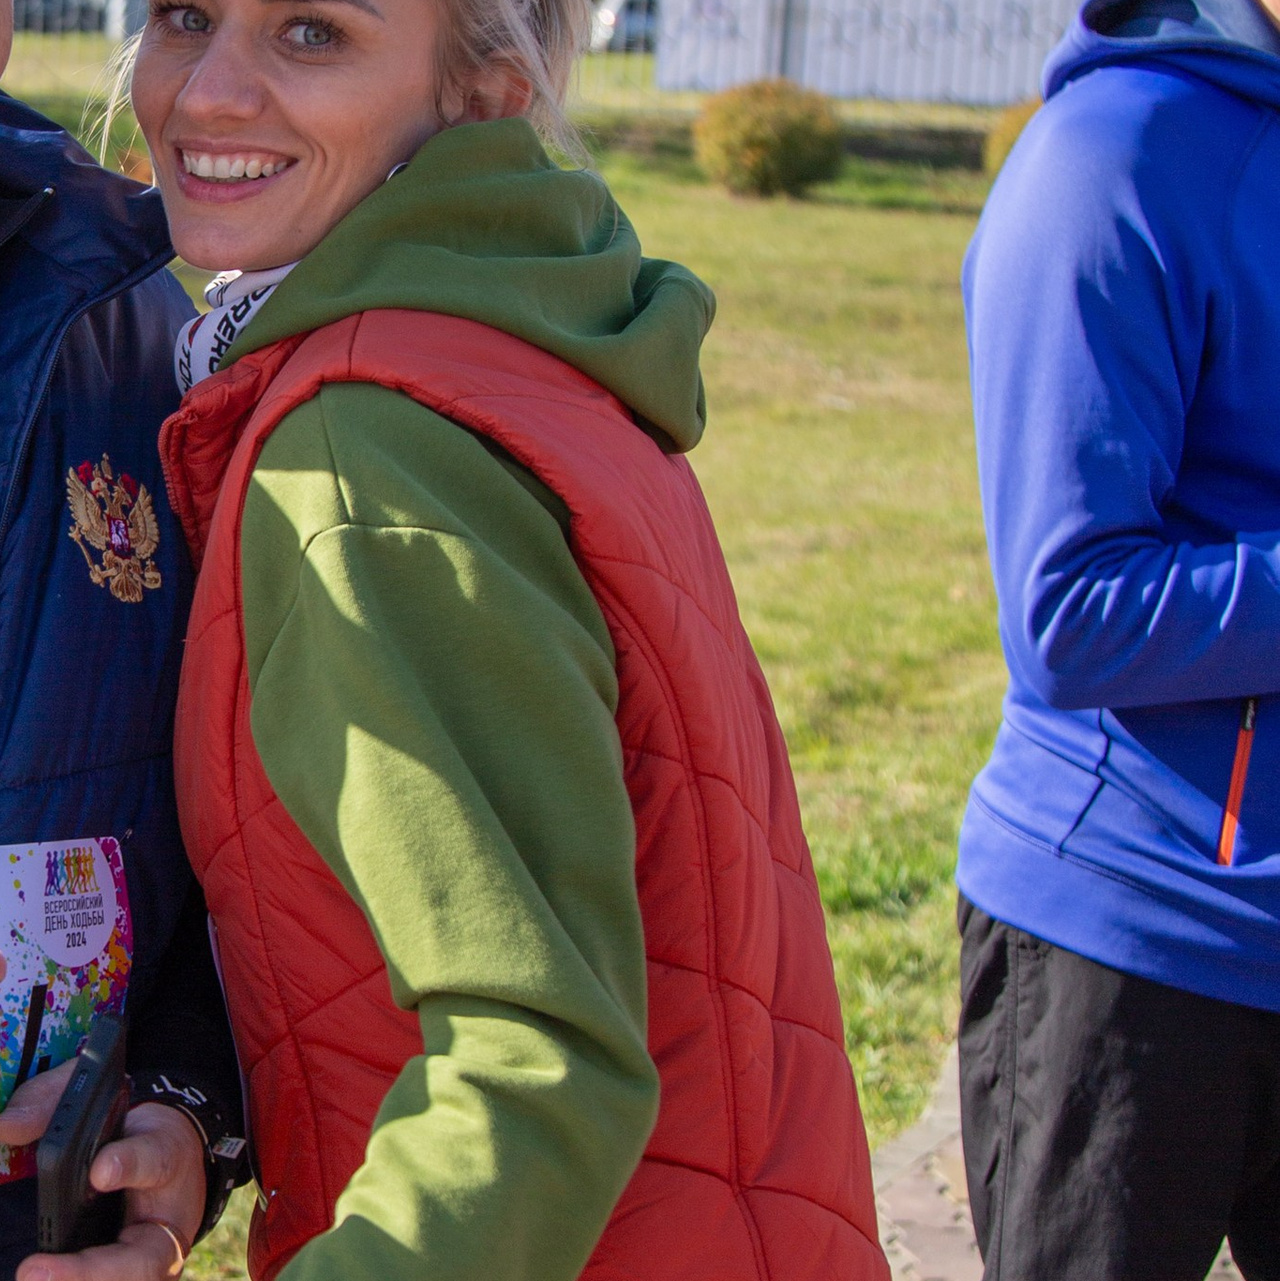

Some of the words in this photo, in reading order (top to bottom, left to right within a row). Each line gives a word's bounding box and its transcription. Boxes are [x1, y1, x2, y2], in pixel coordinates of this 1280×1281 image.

[44, 893, 104, 915] ВСЕРОССИЙСКИЙ
[44, 913, 69, 934] ДЕНЬ
[70, 909, 105, 930] ХОДЬБЫ
[65, 931, 88, 949] 2024
